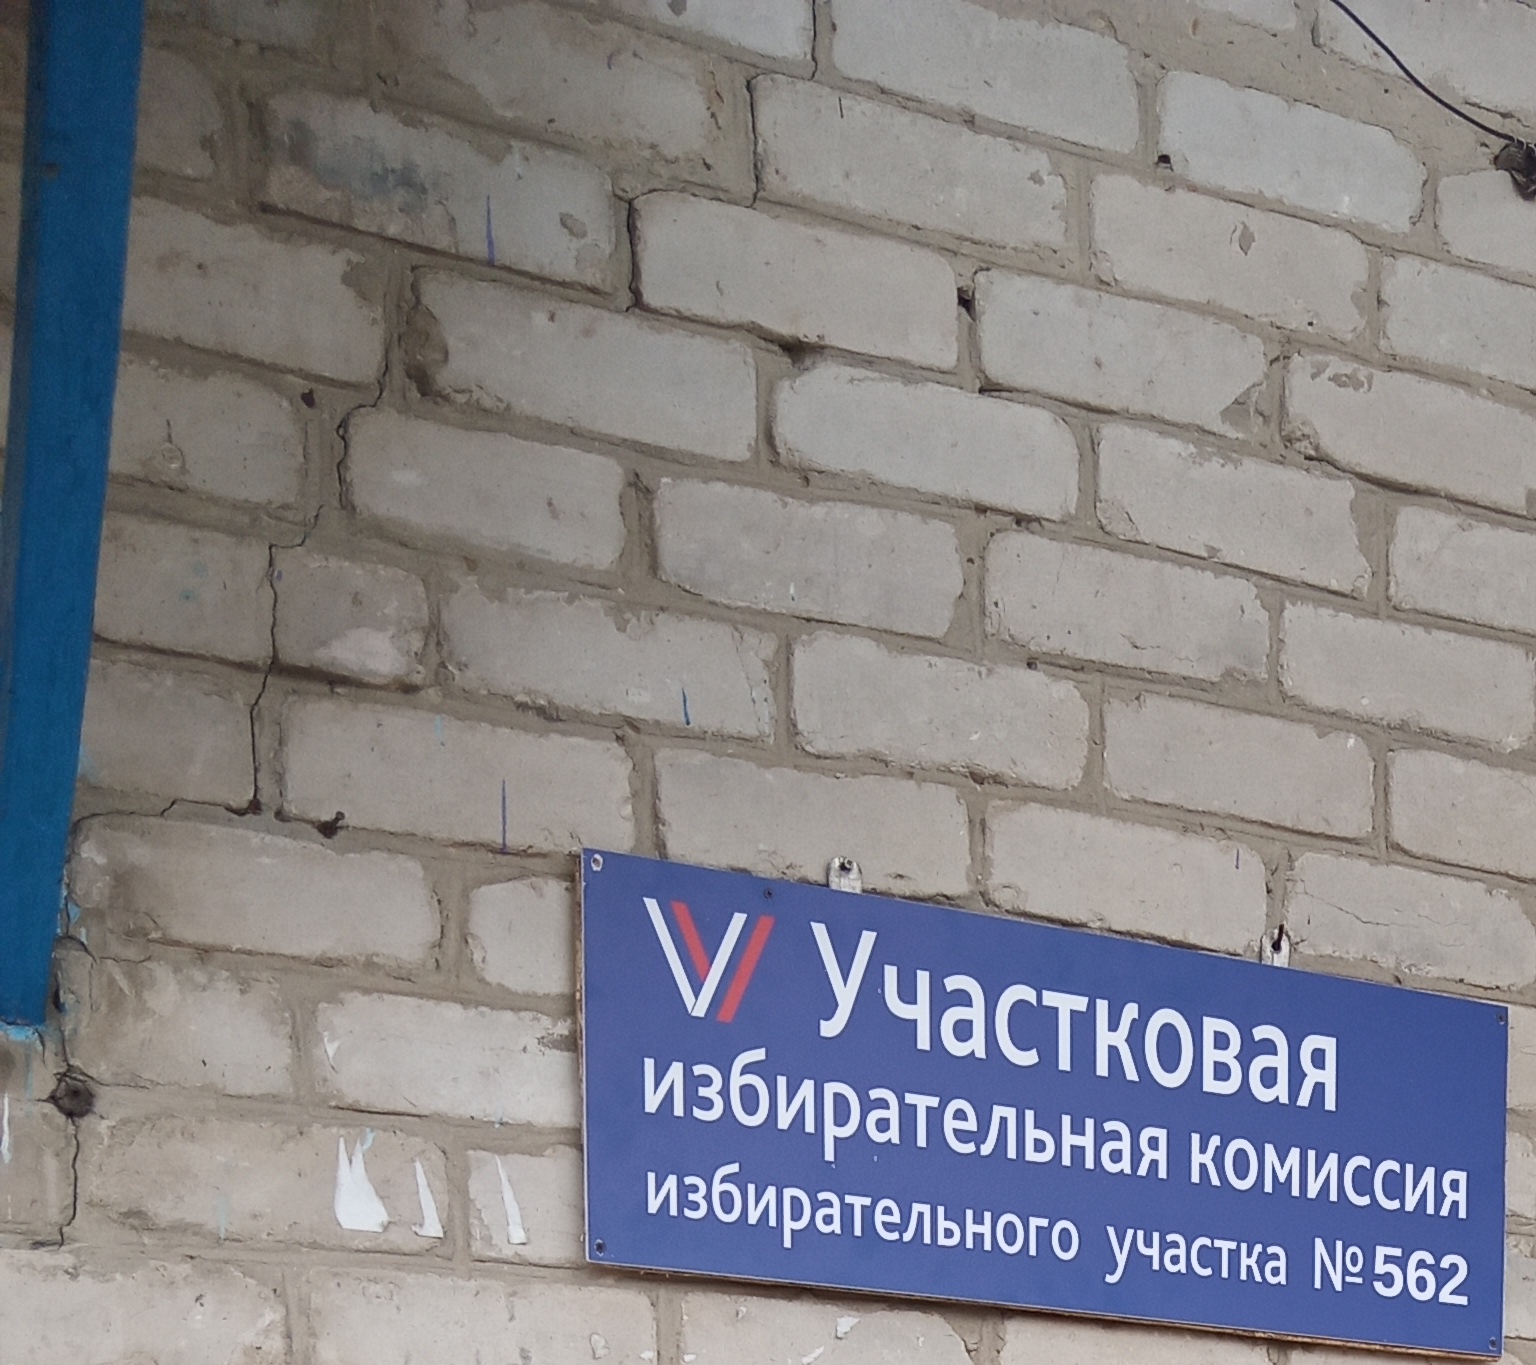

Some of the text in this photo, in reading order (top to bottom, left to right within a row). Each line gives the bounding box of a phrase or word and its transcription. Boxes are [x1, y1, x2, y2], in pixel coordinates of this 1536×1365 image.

[811, 921, 1338, 1112] Участковая
[643, 1048, 1469, 1219] избирательная комиссия
[647, 1162, 1080, 1262] избирательного
[1105, 1224, 1288, 1286] участка
